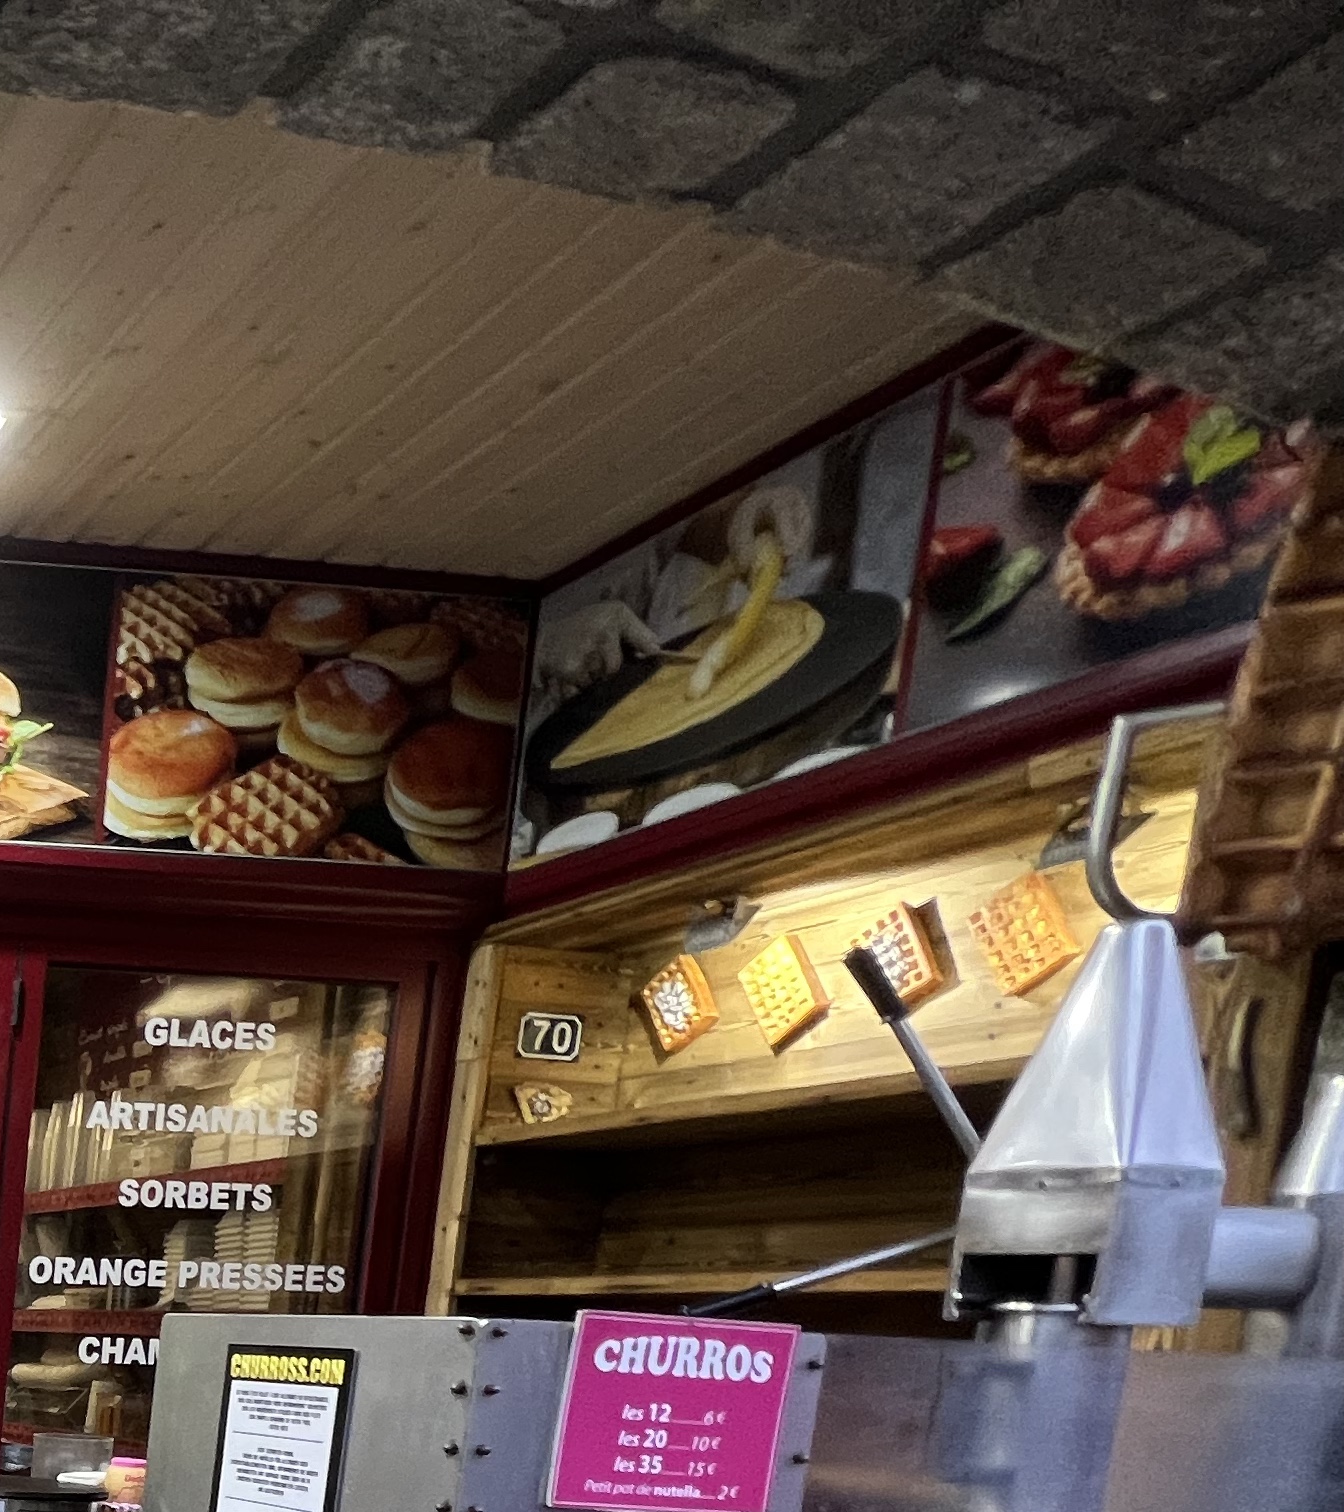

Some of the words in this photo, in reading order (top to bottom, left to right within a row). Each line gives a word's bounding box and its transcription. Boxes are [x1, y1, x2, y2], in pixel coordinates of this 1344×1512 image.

[144, 1017, 277, 1052] GLACES
[533, 1018, 572, 1054] 70
[86, 1100, 318, 1139] ARTISANALES
[118, 1178, 273, 1212] SORBETS
[28, 1255, 169, 1289] ORANGE
[178, 1260, 346, 1294] PRESSEES
[594, 1335, 775, 1383] CHURROS
[649, 1402, 672, 1423] 12
[643, 1428, 668, 1449] 20
[638, 1454, 663, 1475] 35
